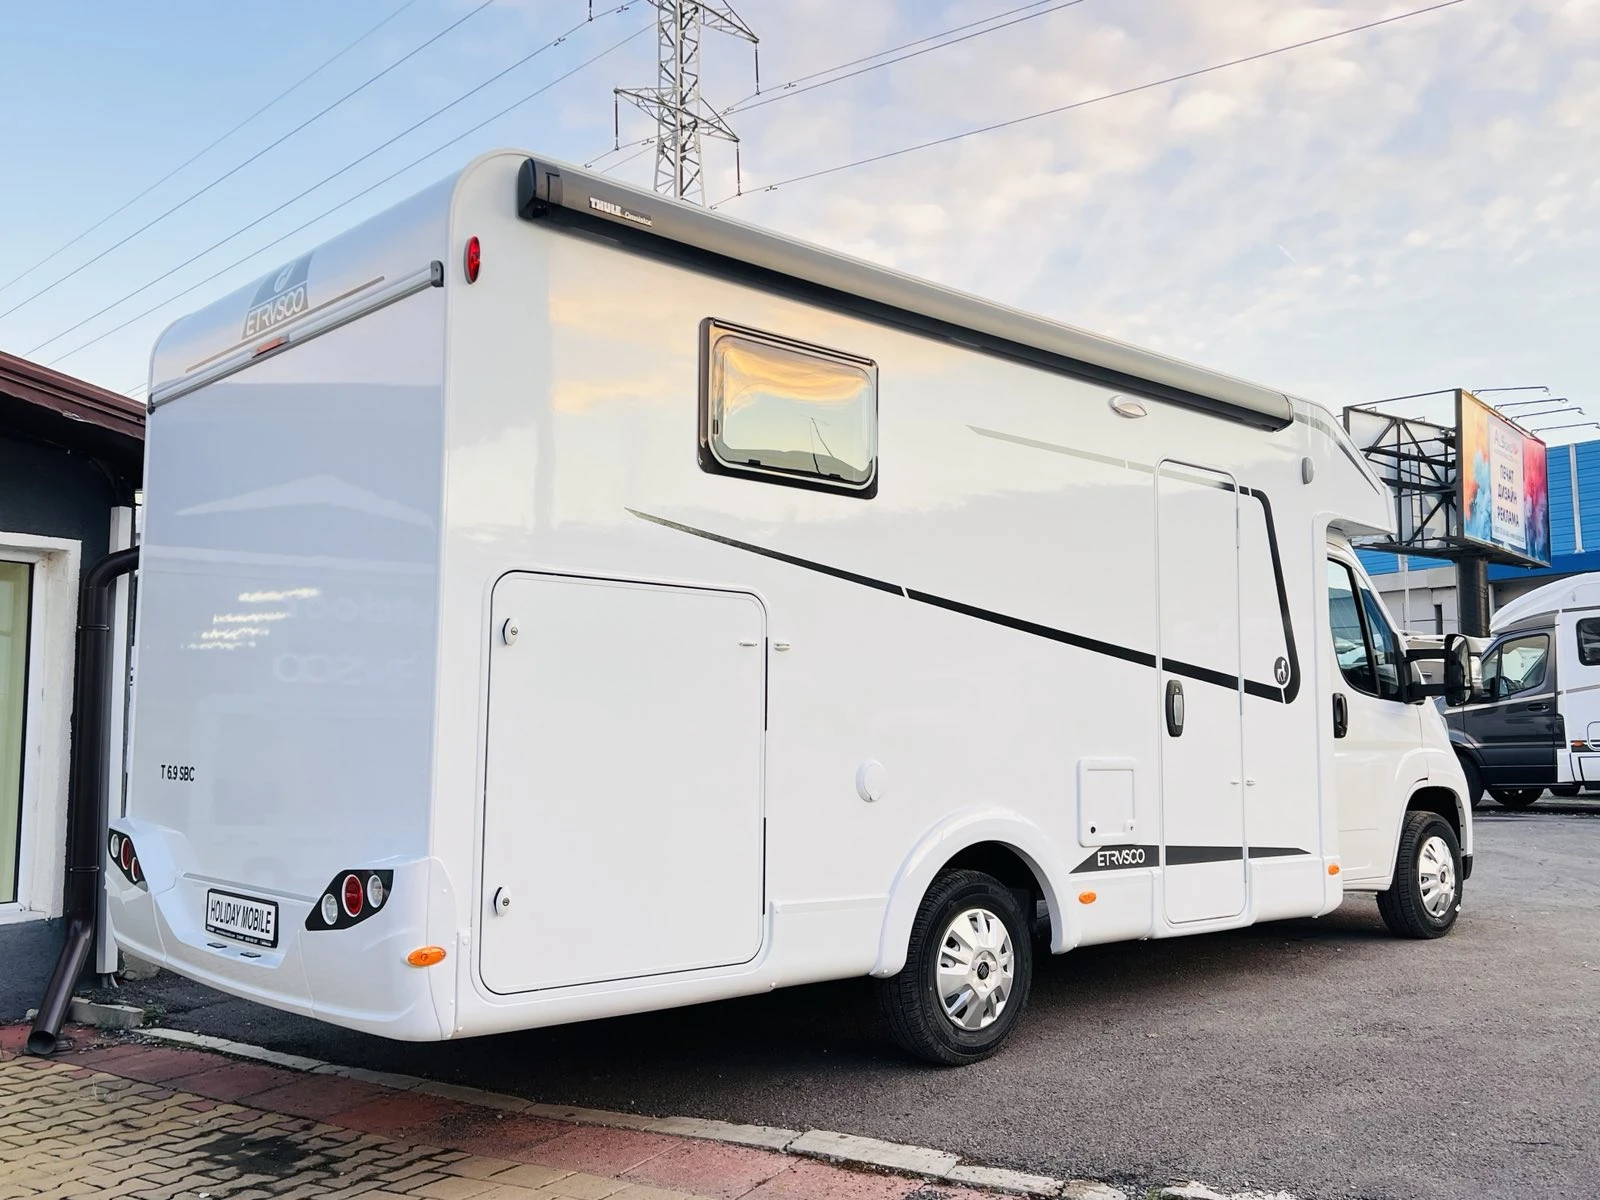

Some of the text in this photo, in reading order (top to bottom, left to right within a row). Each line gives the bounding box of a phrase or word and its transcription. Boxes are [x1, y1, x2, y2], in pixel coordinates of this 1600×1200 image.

[589, 197, 622, 216] THULE
[1500, 464, 1514, 484] ПЕЧАТ
[1498, 484, 1517, 505] ДИЗАЙН
[1497, 507, 1519, 526] РЕКЛАМА
[161, 765, 195, 781] T 6.9 SBC
[210, 899, 272, 934] HOLIDAY MOBILE
